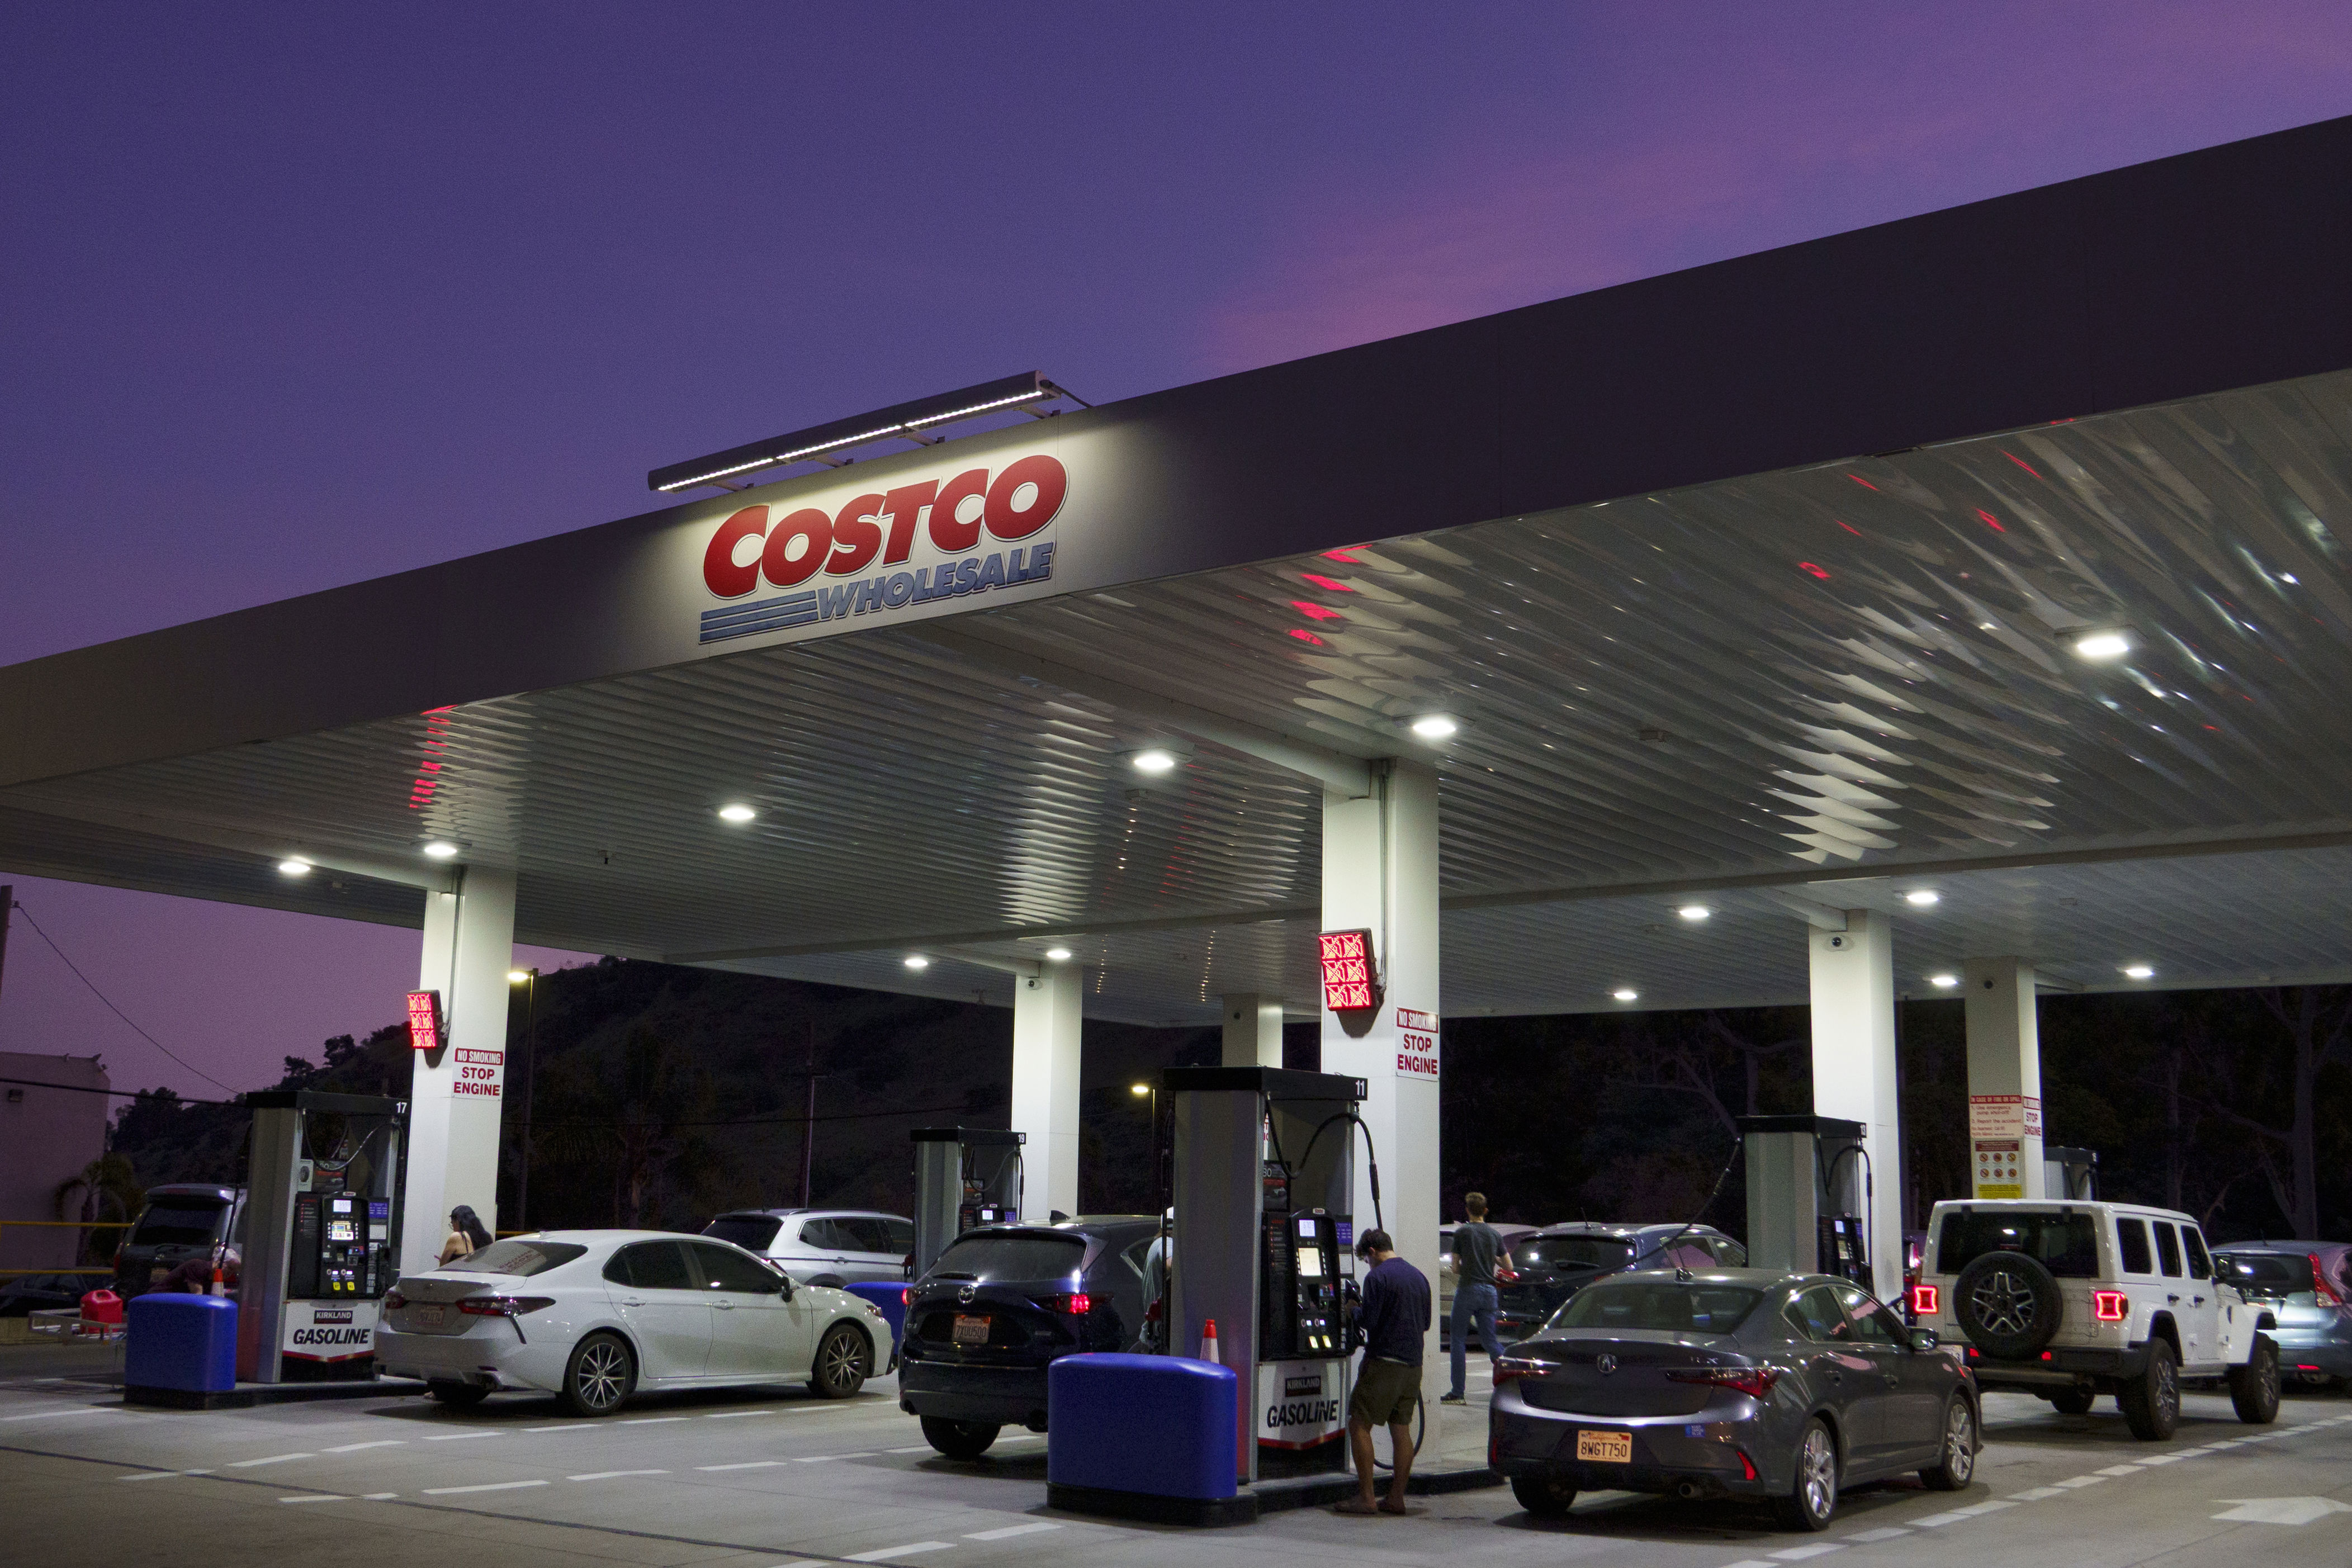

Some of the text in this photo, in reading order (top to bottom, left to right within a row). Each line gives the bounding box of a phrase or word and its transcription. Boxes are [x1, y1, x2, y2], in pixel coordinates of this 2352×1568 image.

[703, 454, 1068, 599] COSTCO
[817, 542, 1054, 620] WHOLESALE
[1399, 1012, 1437, 1031] NO SMOKING
[1403, 1034, 1432, 1052] STOP
[457, 1050, 501, 1064] NO SMOKING
[1397, 1054, 1437, 1074] ENGINE
[462, 1067, 495, 1080] STOP
[453, 1082, 500, 1096] ENGINE
[1356, 1079, 1365, 1096] 11
[396, 1102, 407, 1113] 17
[2026, 1112, 2038, 1122] STOP
[1018, 1134, 1025, 1143] 19
[293, 1328, 370, 1344] GASOLINE
[1287, 1377, 1320, 1390] KIRKLAND
[1267, 1399, 1338, 1428] GASOLINE
[1581, 1441, 1627, 1457] 8WGT750
